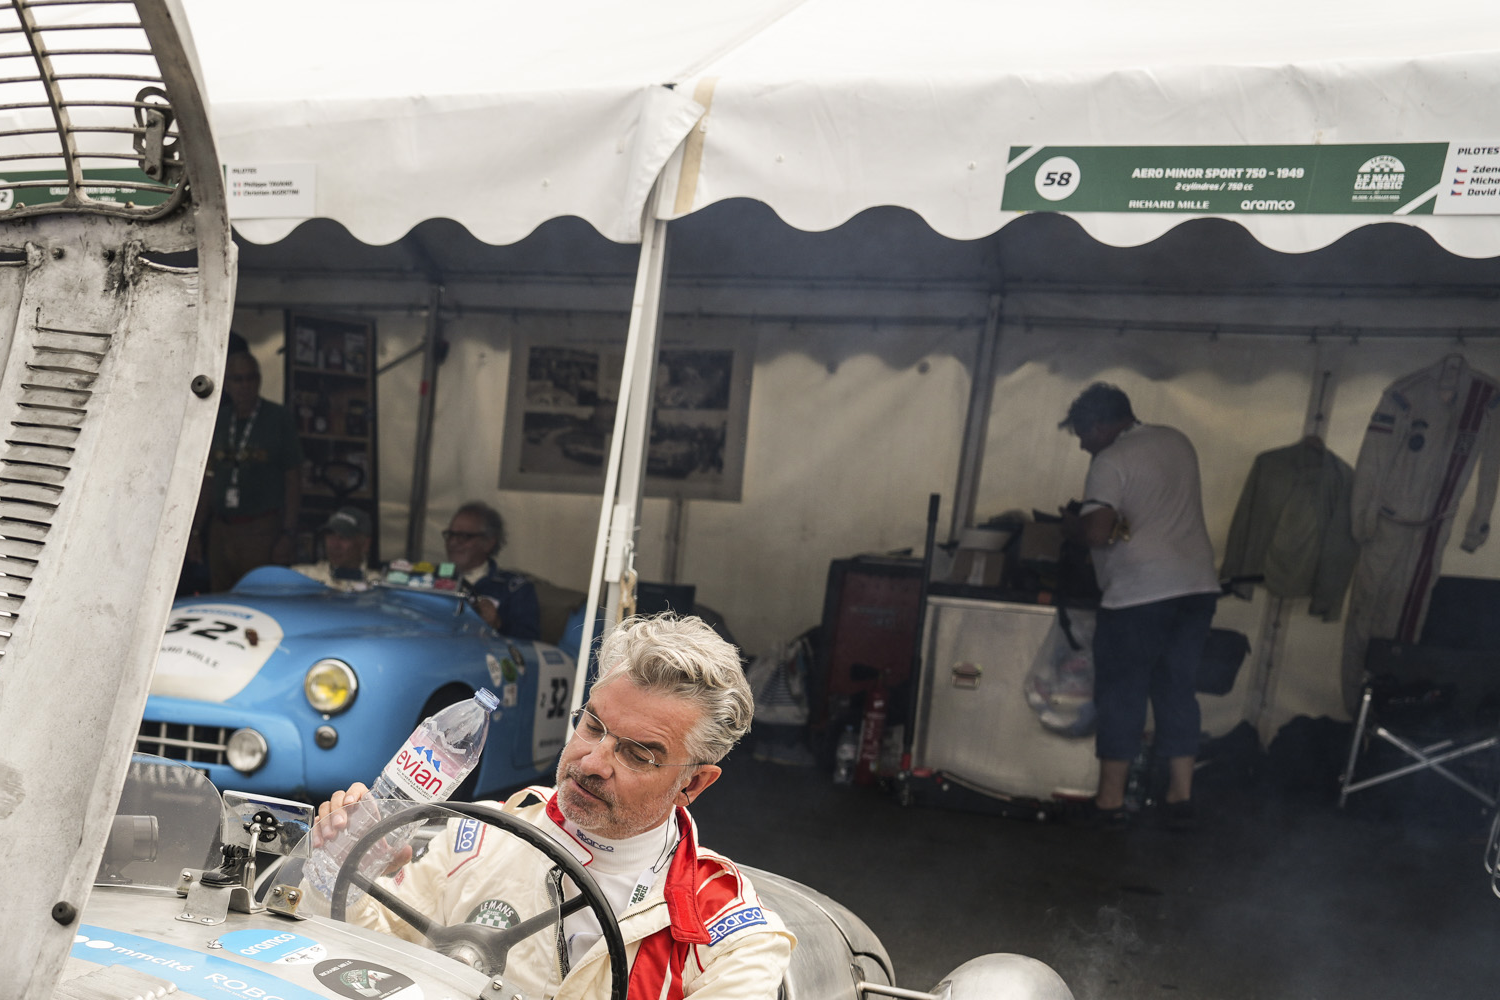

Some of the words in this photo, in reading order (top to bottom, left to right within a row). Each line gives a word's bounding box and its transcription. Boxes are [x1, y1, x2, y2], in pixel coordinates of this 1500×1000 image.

[1457, 147, 1500, 156] PILOTES
[1043, 171, 1072, 187] 58
[1131, 168, 1163, 179] AERO
[1165, 168, 1204, 179] MINOR
[1205, 168, 1244, 179] SPORT
[1245, 168, 1266, 179] 750
[1277, 168, 1305, 179] 1949
[1355, 174, 1371, 184] LE
[1371, 174, 1405, 184] MANS
[1175, 182, 1182, 191] 2
[1182, 182, 1219, 192] cylindres
[1354, 182, 1403, 190] CLASSIC
[1467, 188, 1496, 196] David
[1129, 200, 1175, 209] RICHARD
[1177, 200, 1210, 209] MILLE
[1241, 200, 1295, 210] aramco
[396, 750, 443, 795] evian
[461, 819, 478, 849] arco
[480, 902, 488, 911] LE
[488, 901, 514, 917] MANS
[708, 909, 763, 940] sparco
[240, 933, 297, 955] aramco
